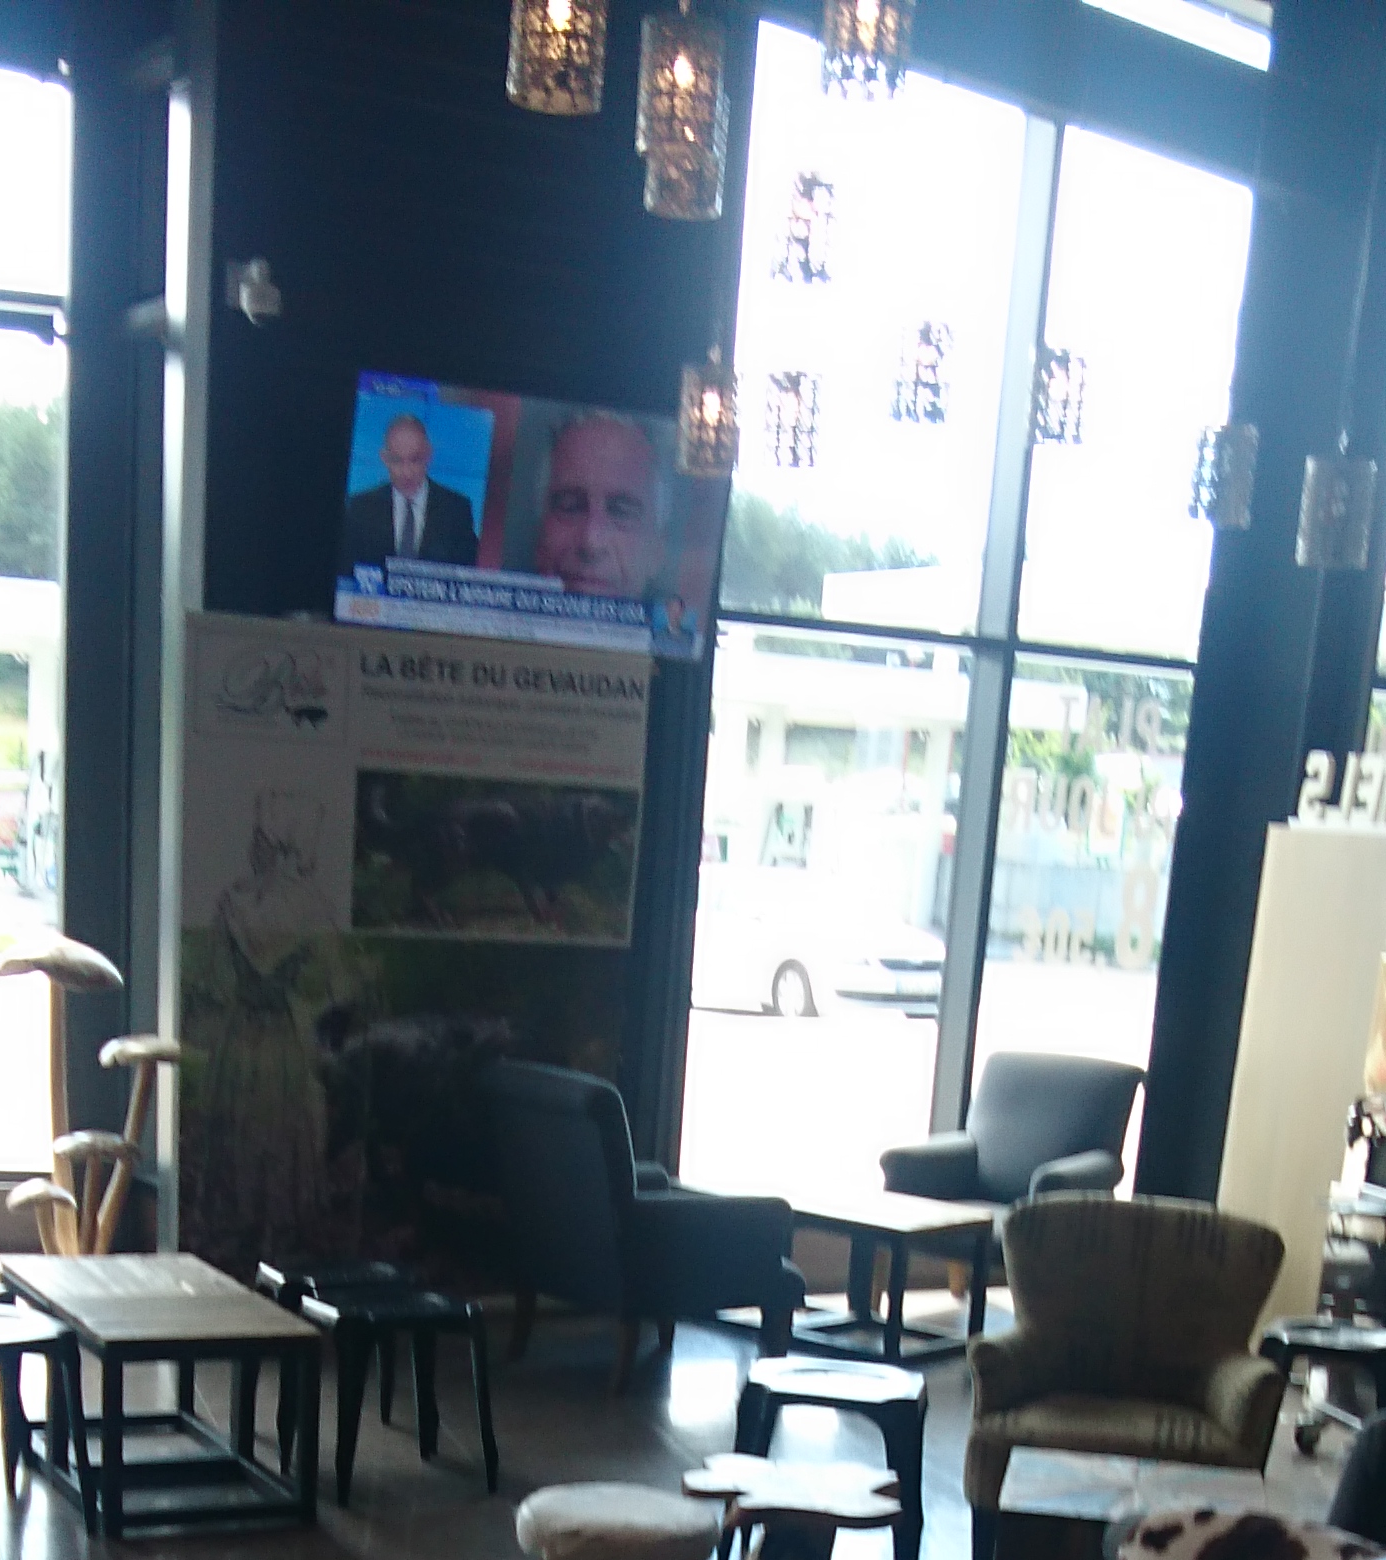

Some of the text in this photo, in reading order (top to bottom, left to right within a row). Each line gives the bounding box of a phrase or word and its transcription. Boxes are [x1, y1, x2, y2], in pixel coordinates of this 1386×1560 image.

[359, 652, 393, 680] LA
[398, 651, 465, 685] BÊTE
[471, 661, 508, 690] DU
